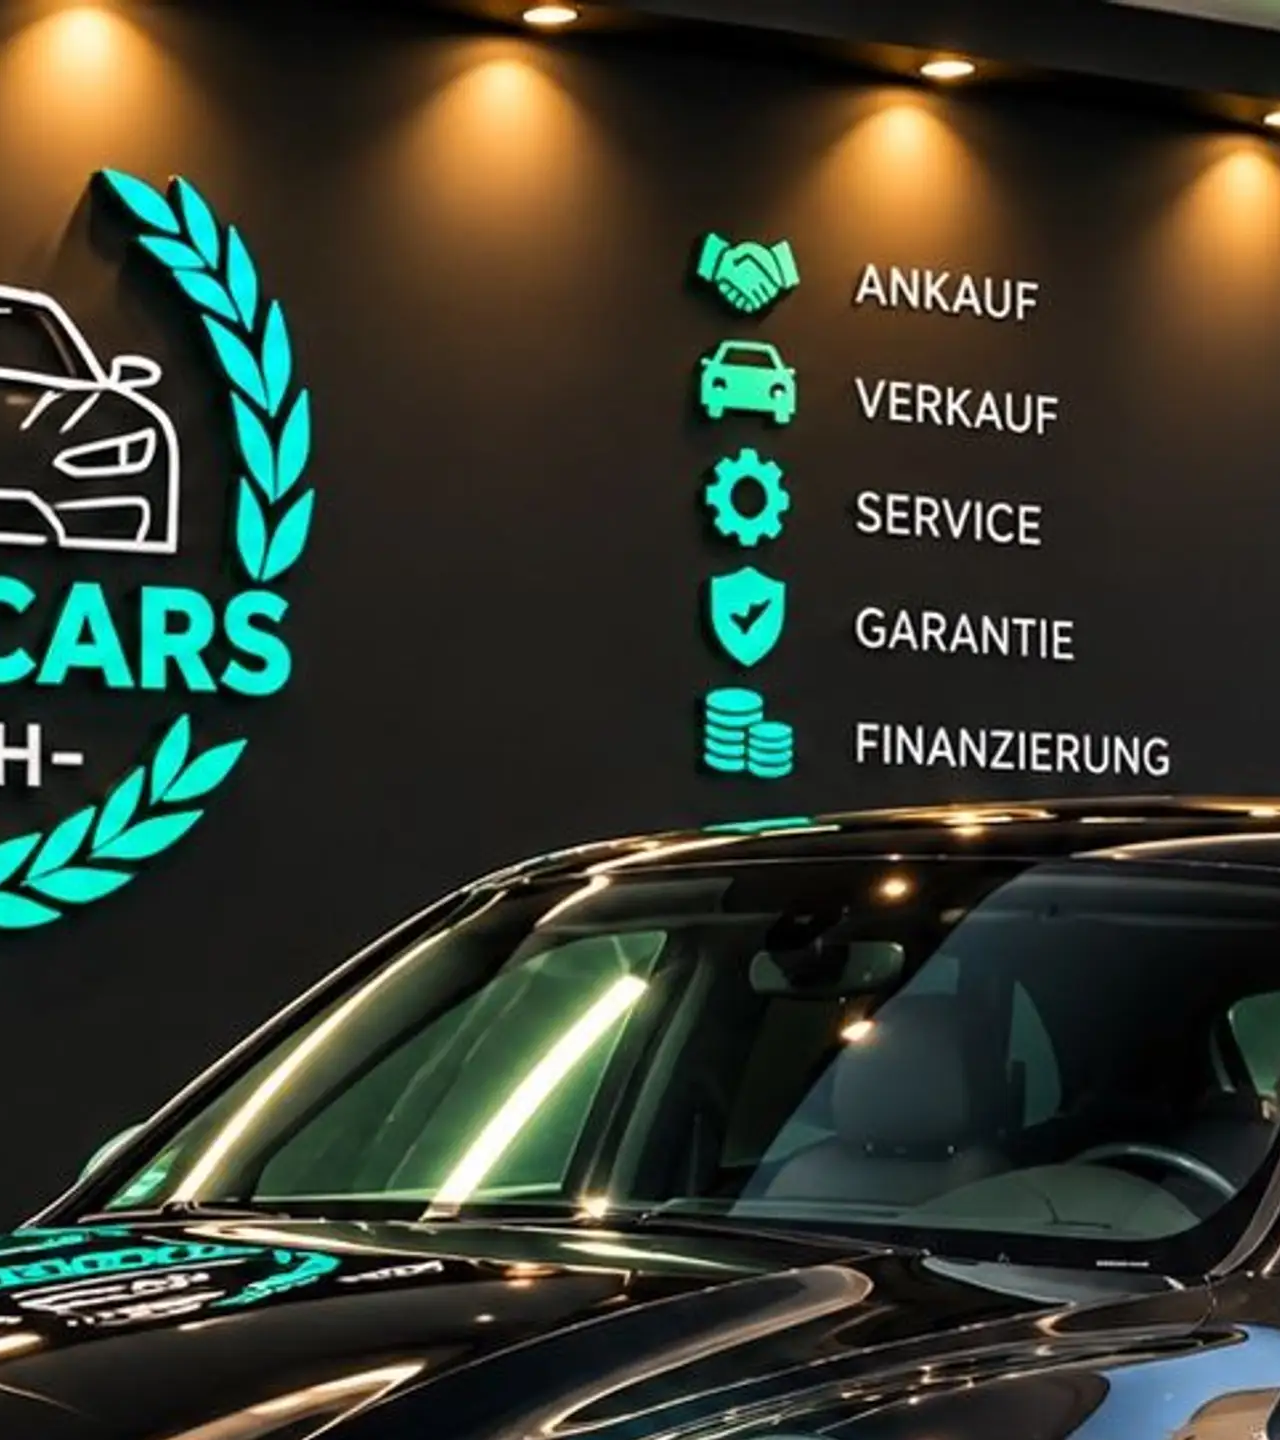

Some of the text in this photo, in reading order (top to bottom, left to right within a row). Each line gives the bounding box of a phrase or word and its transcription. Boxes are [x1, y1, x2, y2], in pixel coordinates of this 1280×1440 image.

[854, 262, 1040, 321] ANKAUF
[854, 376, 1060, 436] VERKAUF
[855, 490, 1043, 547] SERVICE
[854, 605, 1075, 661] GARANTIE
[855, 721, 1171, 778] FINANZIERUNG
